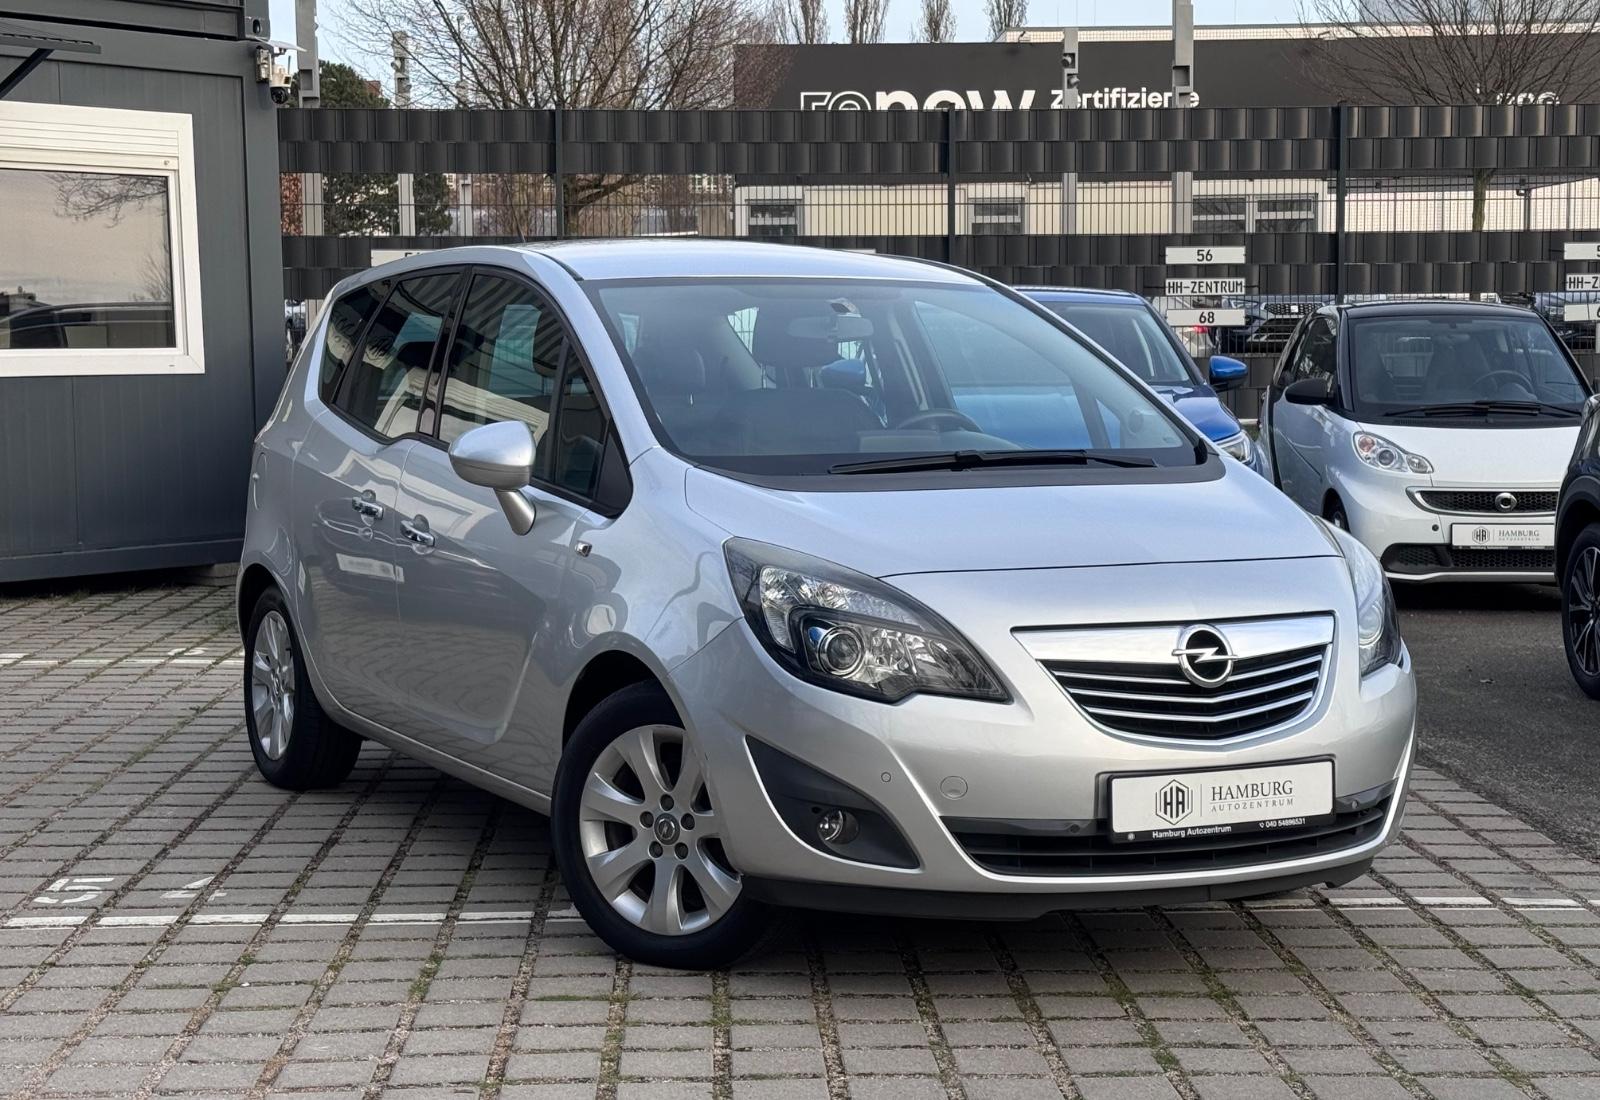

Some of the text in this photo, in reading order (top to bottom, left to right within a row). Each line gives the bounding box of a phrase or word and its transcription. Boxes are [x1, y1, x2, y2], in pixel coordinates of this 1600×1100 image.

[1051, 87, 1200, 109] Zrtifiziere
[1196, 249, 1213, 262] 56
[1167, 280, 1243, 294] HH-ZENTRUM
[1199, 311, 1215, 324] 68
[1211, 780, 1293, 801] HAMBURG
[1211, 798, 1294, 813] AUTOZENTRUM
[1152, 826, 1232, 839] Hamburg Autozentrum
